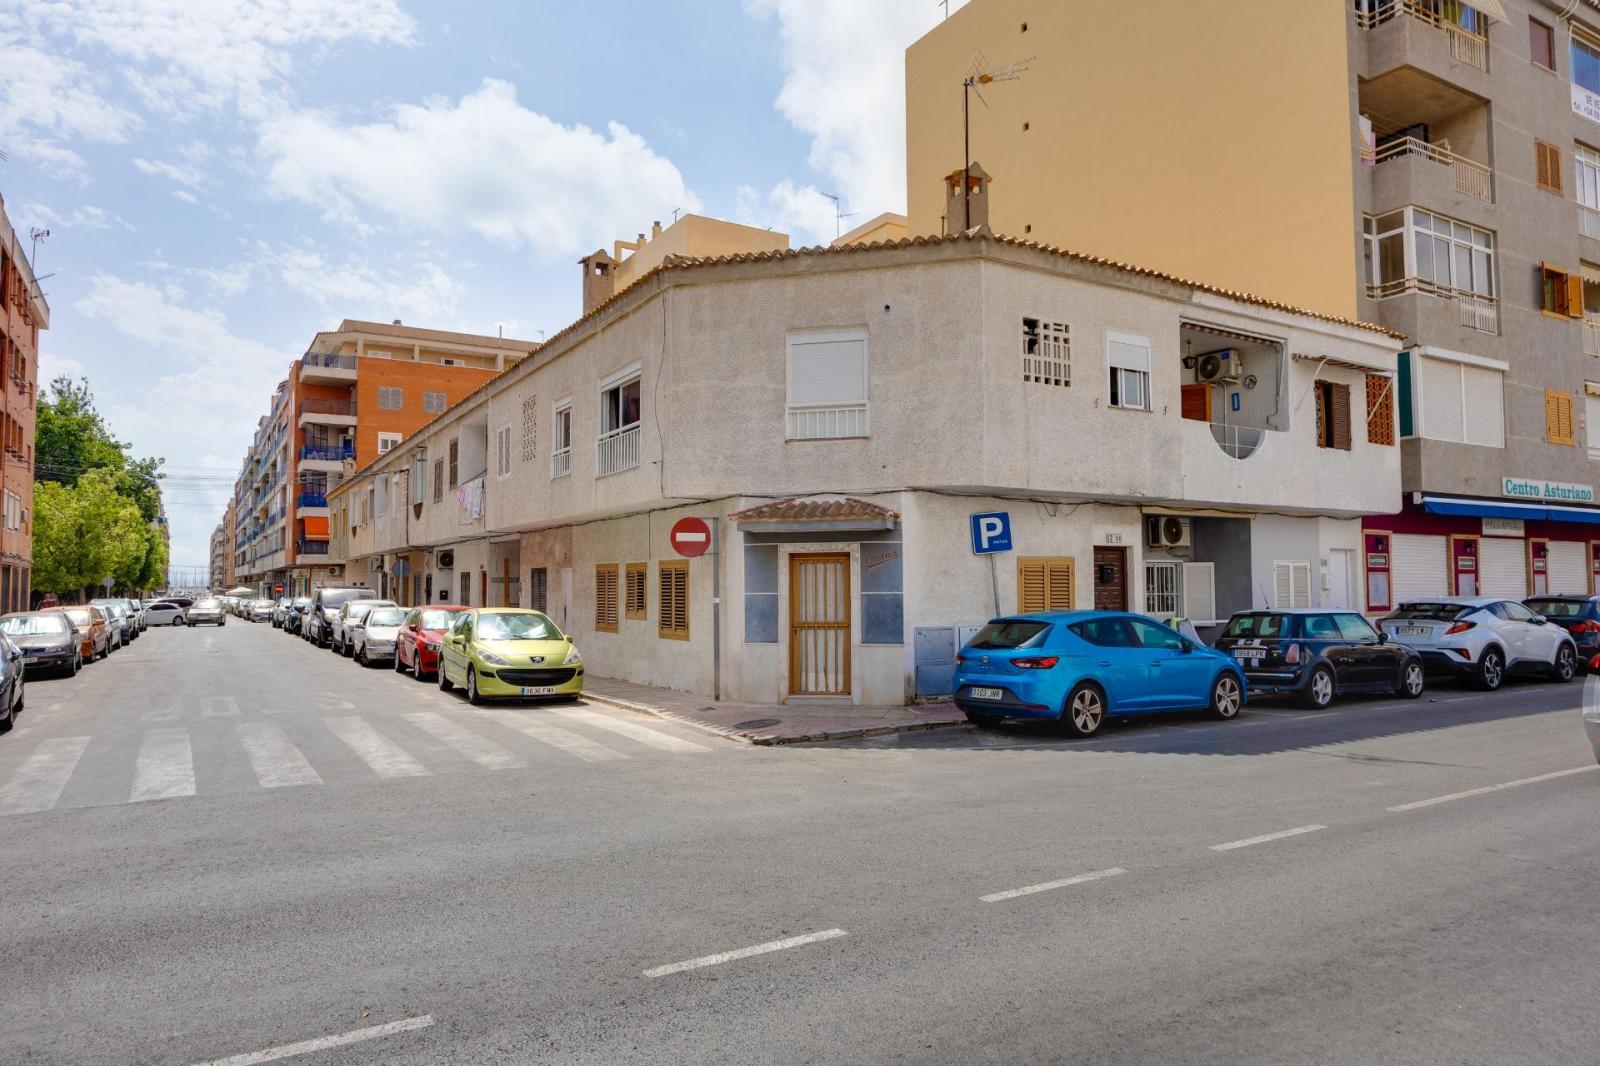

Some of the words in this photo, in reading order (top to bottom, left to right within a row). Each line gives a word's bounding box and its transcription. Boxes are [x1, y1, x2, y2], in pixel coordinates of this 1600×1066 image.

[1505, 479, 1540, 496] Centro
[1544, 482, 1592, 500] Asturiano
[980, 517, 1003, 549] P
